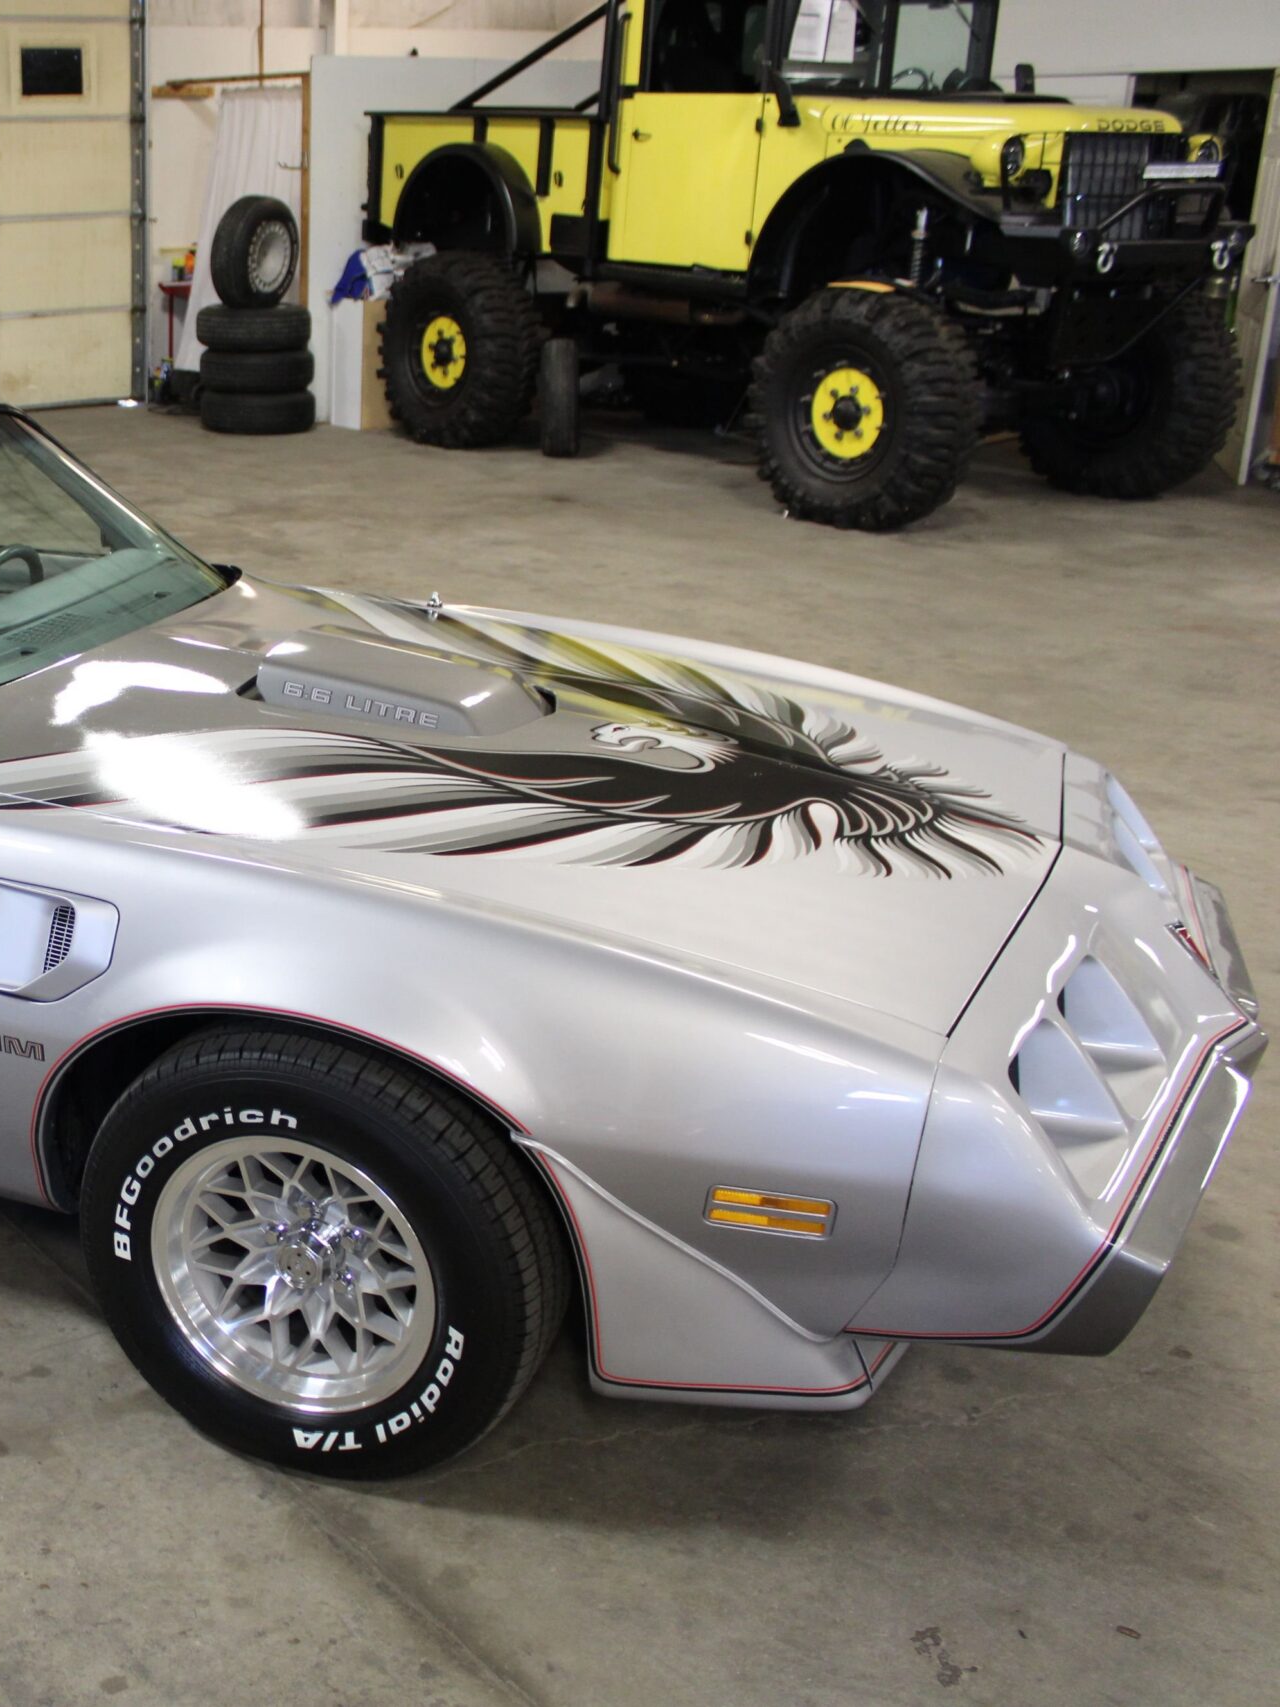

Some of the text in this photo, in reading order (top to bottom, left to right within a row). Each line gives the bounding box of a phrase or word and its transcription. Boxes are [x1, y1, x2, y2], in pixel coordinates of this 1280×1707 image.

[1097, 119, 1166, 132] DODGE
[283, 680, 439, 729] 6.6 LITRE
[113, 1106, 298, 1261] BFGoodrich
[292, 1325, 464, 1452] Radial T/A
